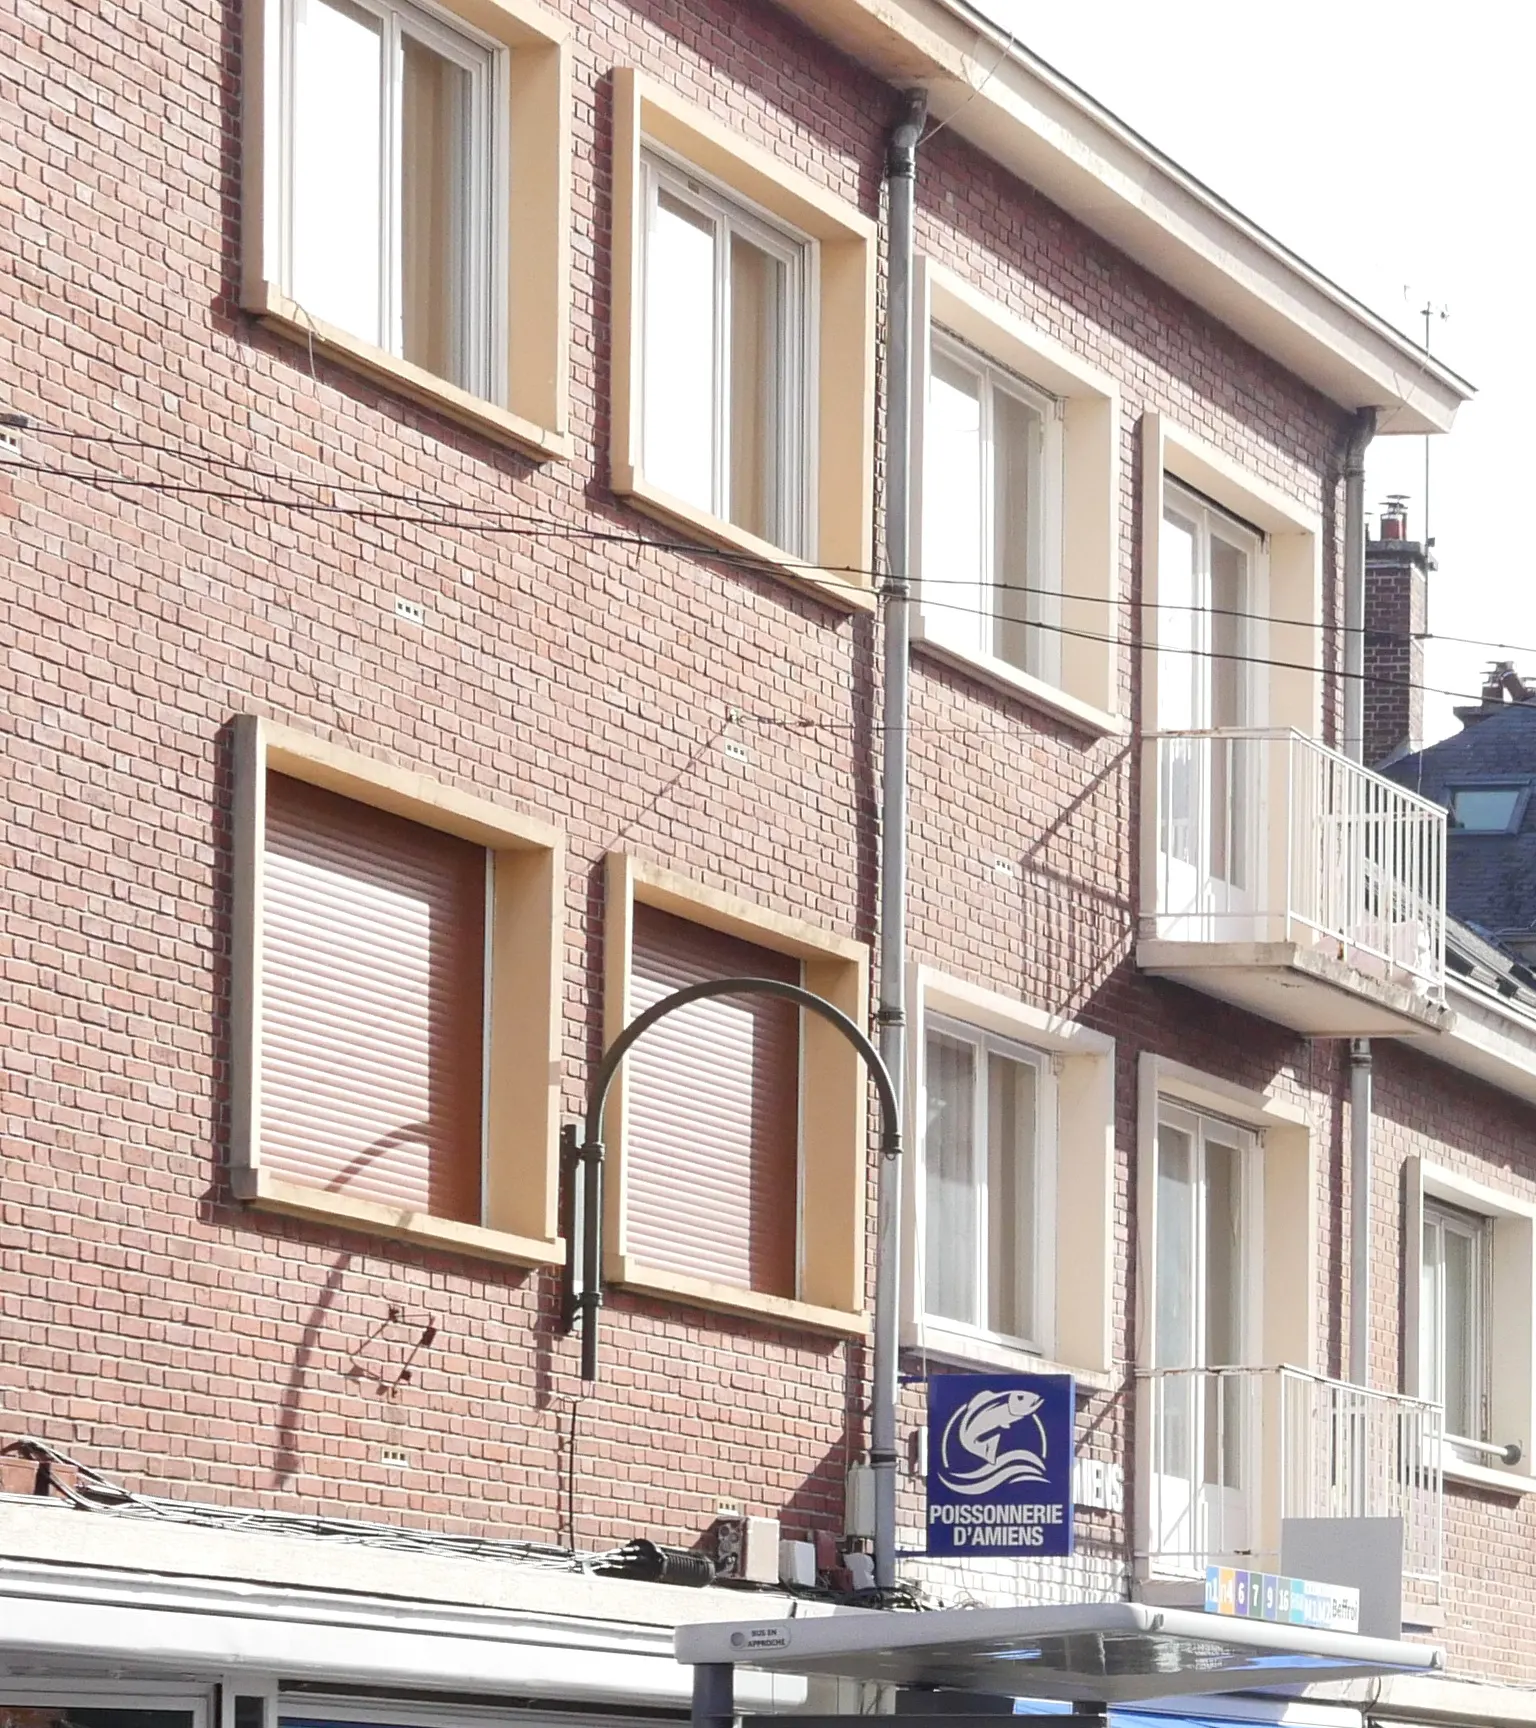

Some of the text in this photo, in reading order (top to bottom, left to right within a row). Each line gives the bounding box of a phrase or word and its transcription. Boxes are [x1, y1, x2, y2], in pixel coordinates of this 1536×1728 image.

[930, 1504, 1063, 1525] POISSONNERIE
[953, 1526, 1044, 1547] D'AMIENS
[1238, 1583, 1245, 1605] 6
[1252, 1584, 1260, 1607] 7
[1266, 1586, 1273, 1609] 9
[1278, 1589, 1289, 1612] 16
